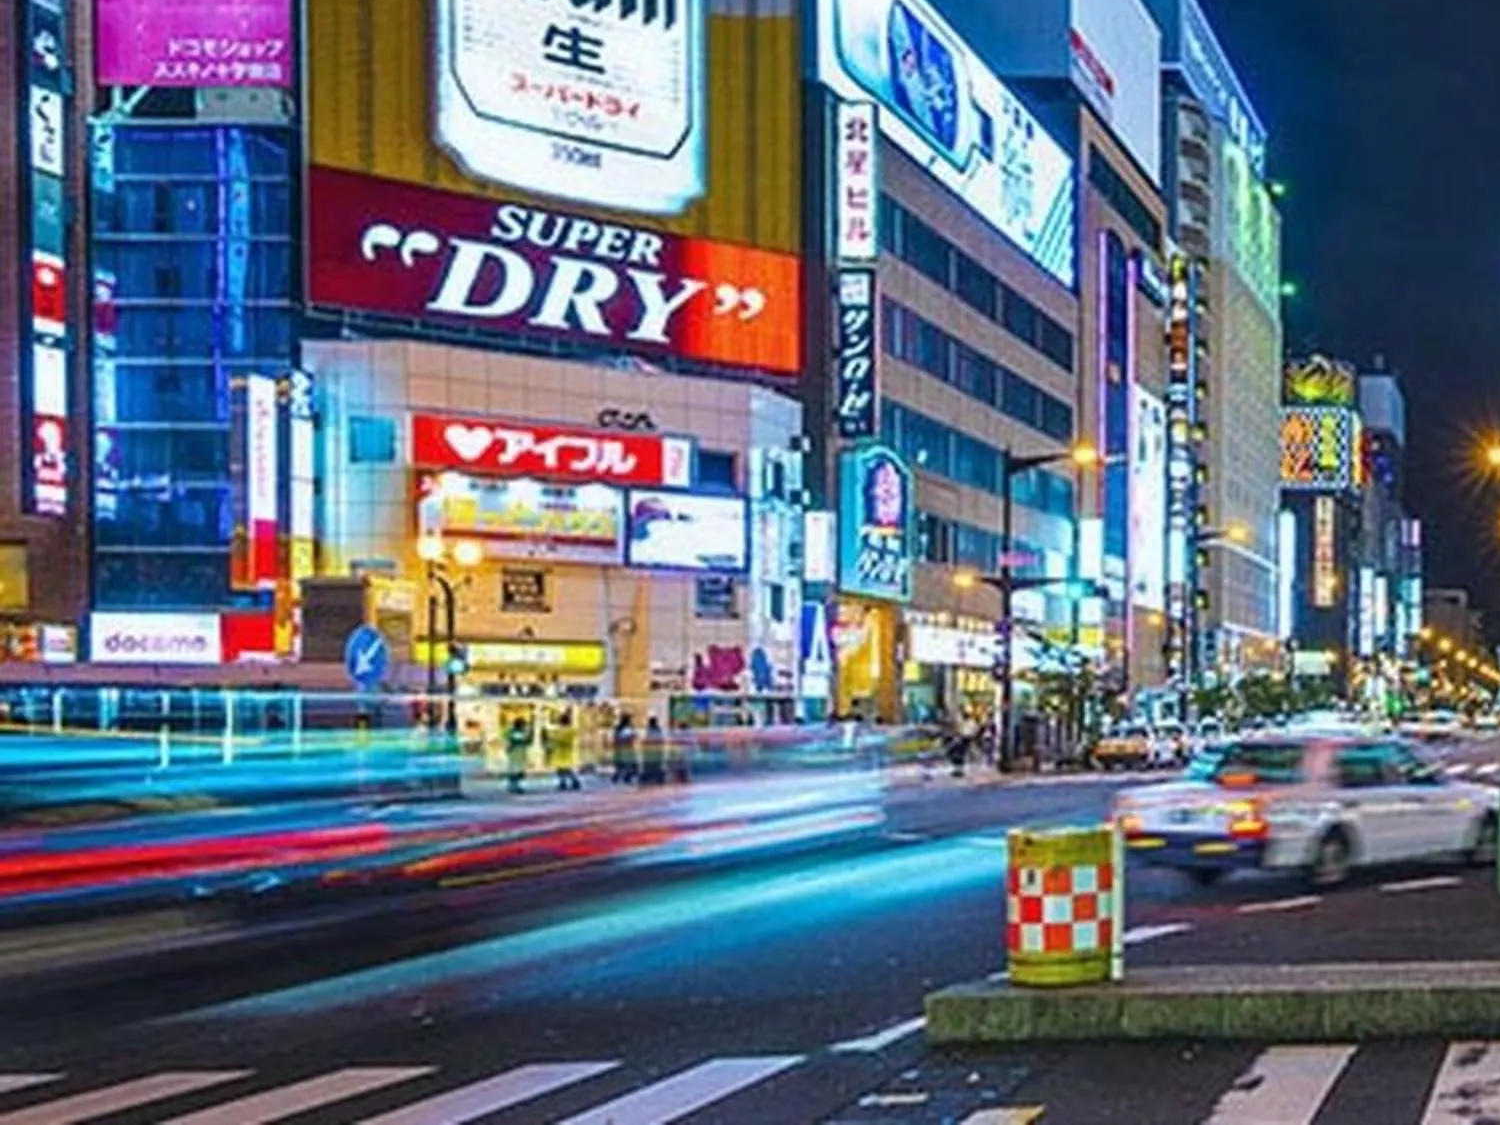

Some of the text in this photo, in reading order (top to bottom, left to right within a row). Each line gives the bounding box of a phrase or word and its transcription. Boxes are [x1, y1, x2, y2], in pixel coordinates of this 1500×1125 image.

[168, 39, 283, 57] ドコモショップ
[542, 24, 606, 75] 生
[511, 71, 641, 119] スーパードライ
[490, 203, 664, 267] SUPER
[493, 430, 638, 475] アイフル
[104, 627, 207, 653] docomo
